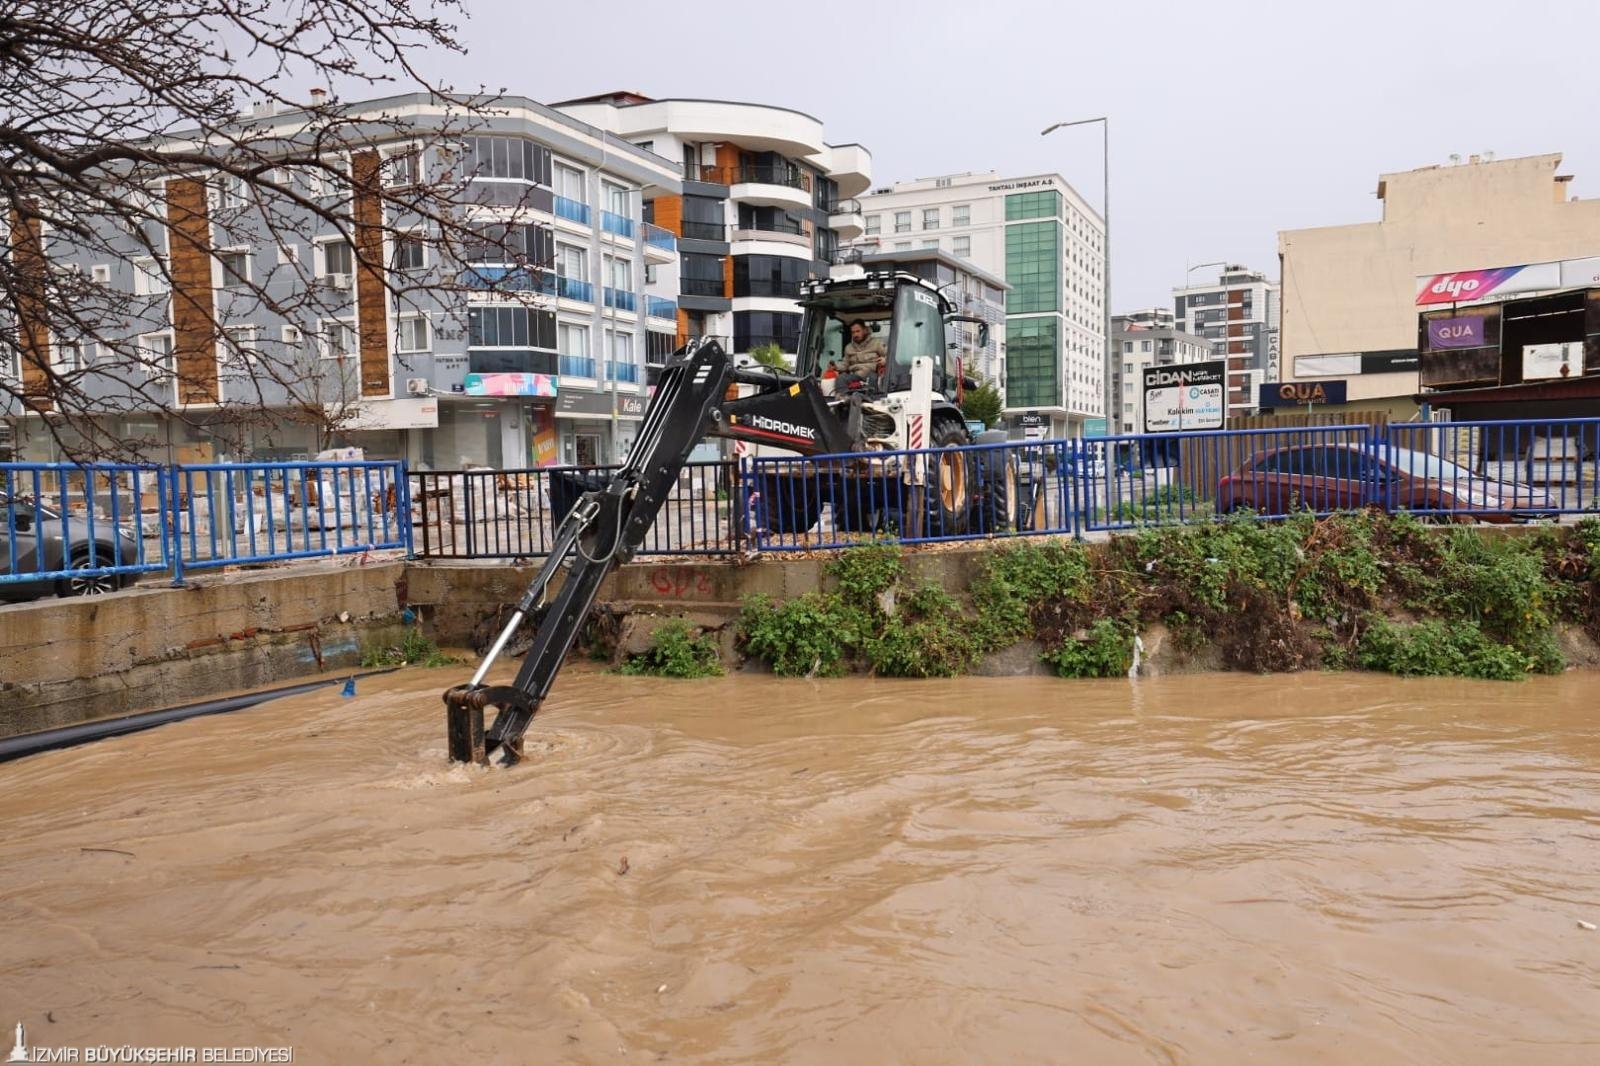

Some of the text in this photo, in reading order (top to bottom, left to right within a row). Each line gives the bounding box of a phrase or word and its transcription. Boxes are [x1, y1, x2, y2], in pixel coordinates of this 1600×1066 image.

[1432, 276, 1480, 297] dyo
[1438, 325, 1474, 339] QUA
[1280, 383, 1327, 400] QUA
[624, 399, 641, 412] Kale
